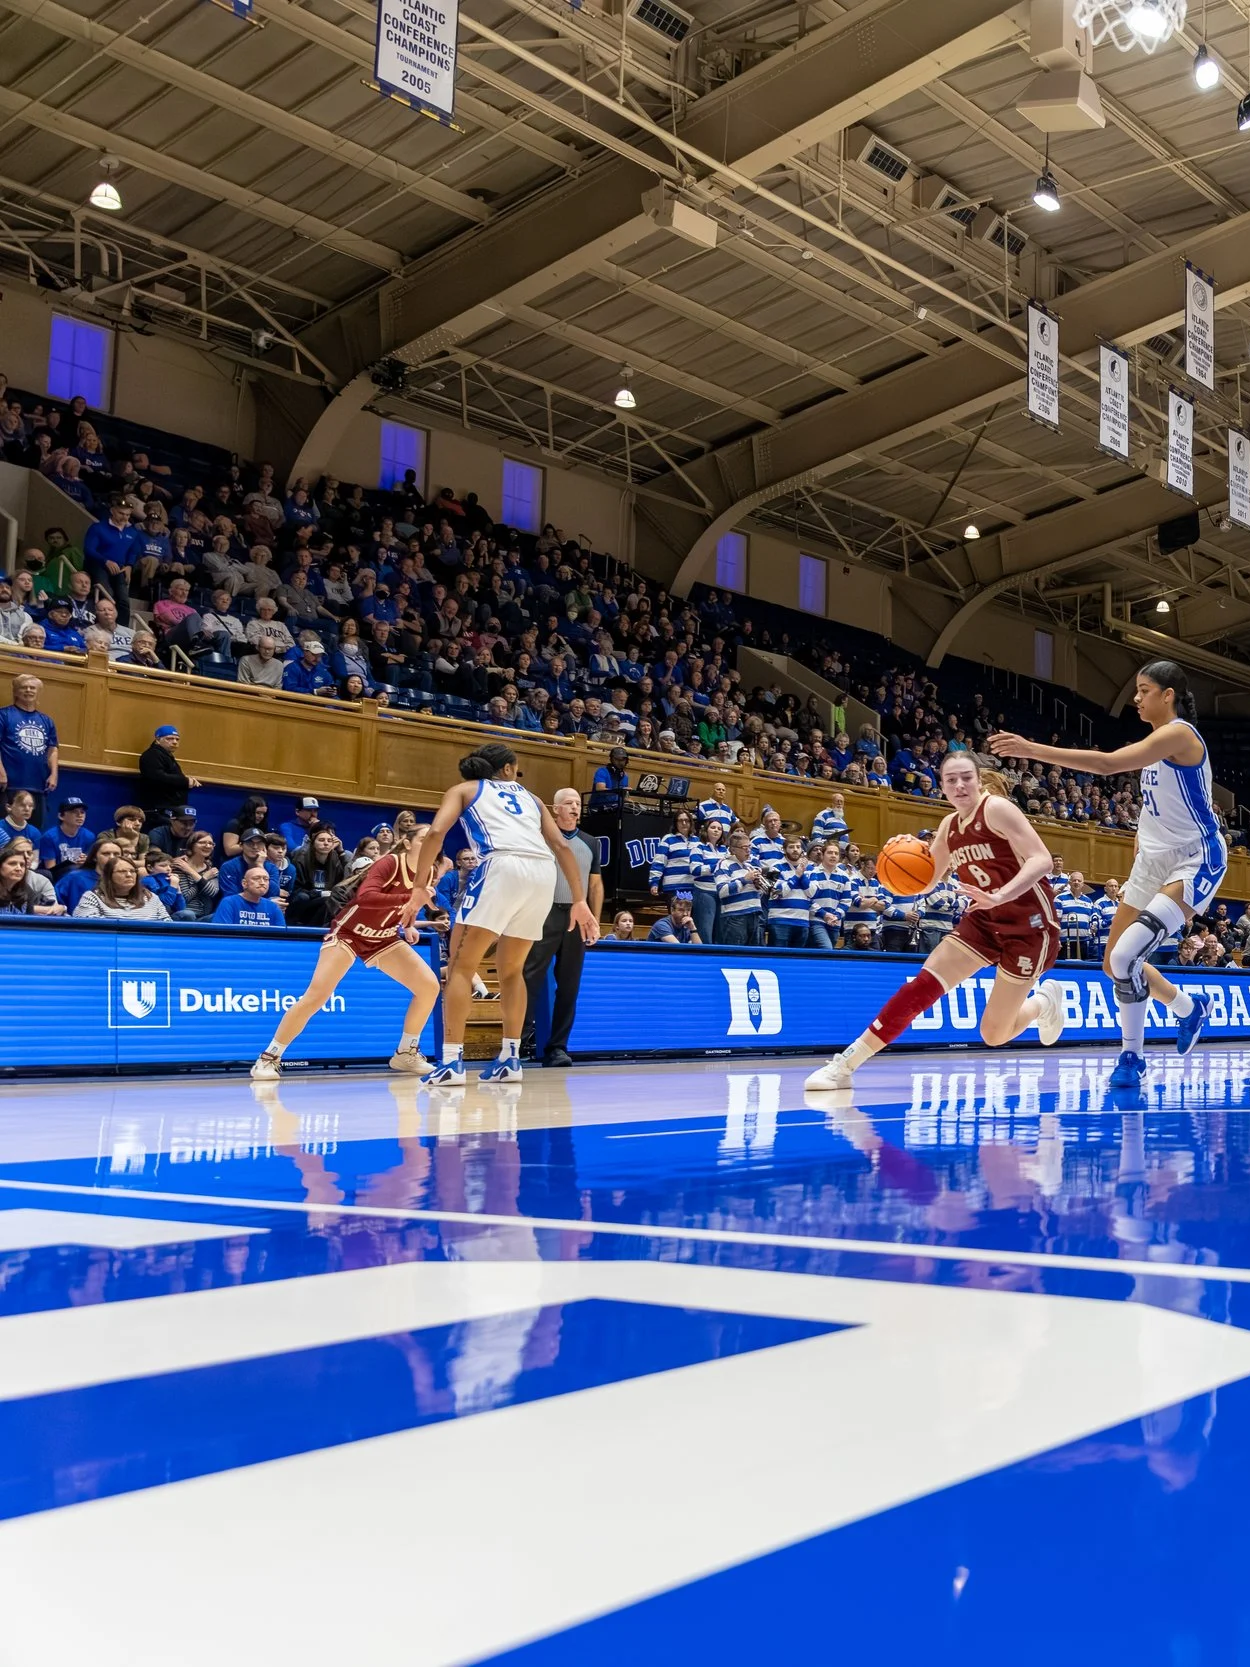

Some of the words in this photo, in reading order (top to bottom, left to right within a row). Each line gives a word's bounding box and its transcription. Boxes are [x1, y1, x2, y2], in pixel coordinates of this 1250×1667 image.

[401, 0, 446, 25] LANTIC
[403, 9, 438, 35] COAST
[384, 13, 454, 59] CONFERENCE
[386, 30, 451, 72] CHAMPIONS
[396, 52, 438, 79] TOURNAMENT
[401, 70, 431, 94] 2005
[1191, 313, 1209, 332] ATLANTIC
[1188, 330, 1213, 354] CONFERENCE
[1189, 341, 1212, 363] CHAMPIONS
[1034, 350, 1054, 367] ATLANTIC
[1030, 367, 1058, 388] CONFERENCE
[1105, 386, 1124, 402] ATLANTIC
[72, 608, 96, 623] UKE
[1140, 769, 1158, 786] UKE
[498, 791, 523, 815] 3
[625, 837, 662, 868] DU
[949, 843, 995, 869] BOSTON
[968, 864, 991, 888] 8
[353, 923, 399, 939] COLLEGE
[180, 988, 345, 1013] DukeHeth
[721, 968, 783, 1036] D
